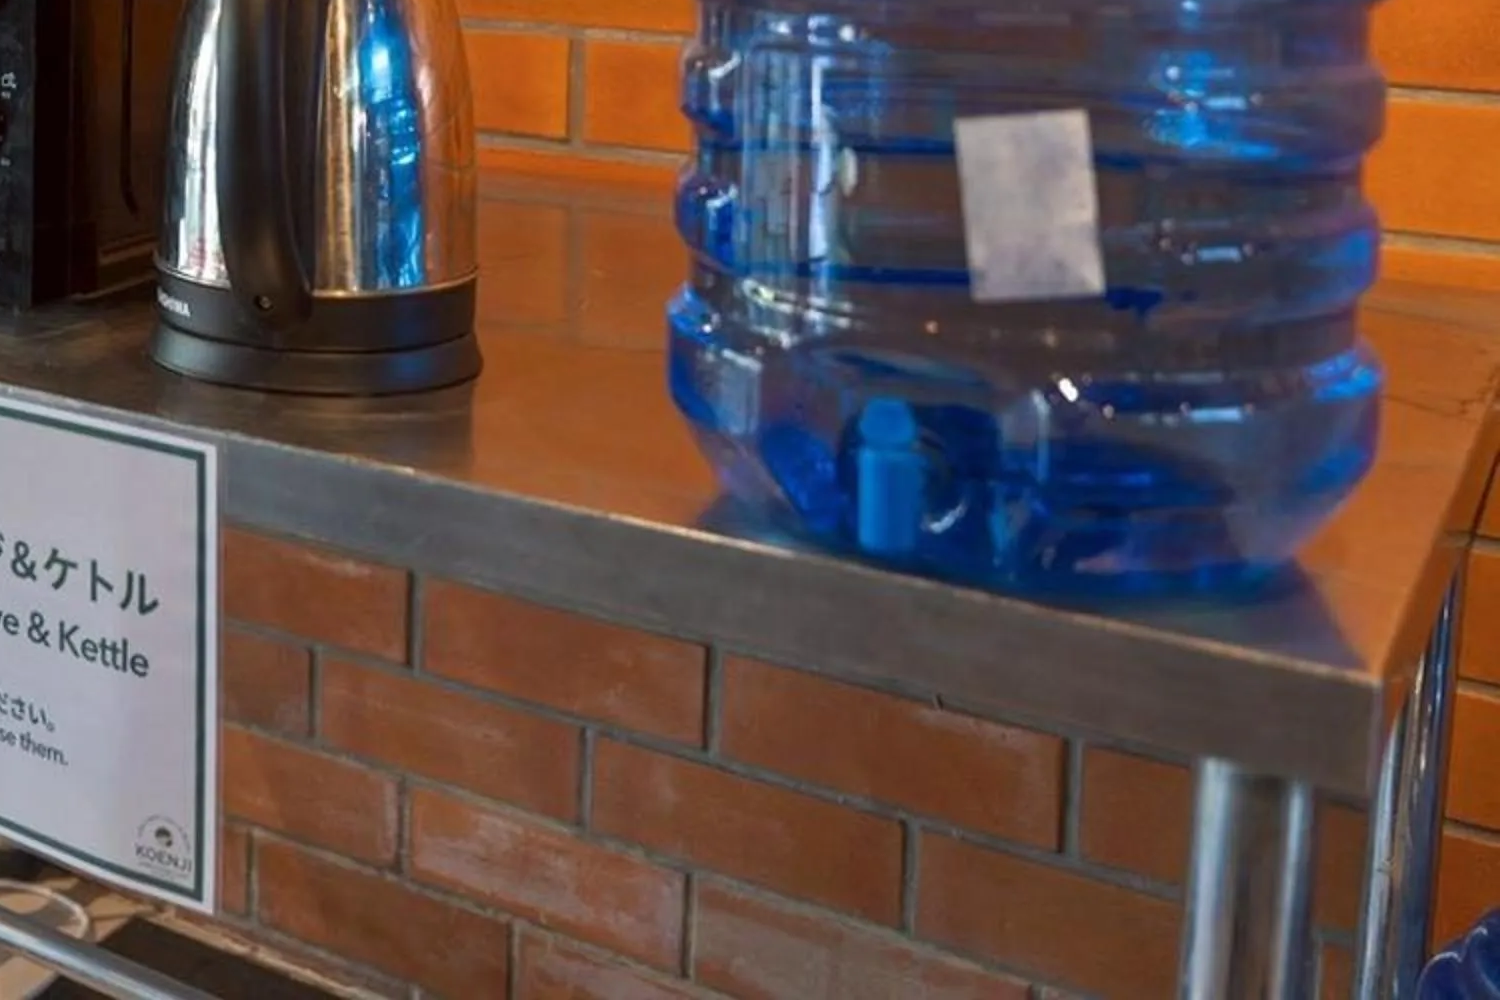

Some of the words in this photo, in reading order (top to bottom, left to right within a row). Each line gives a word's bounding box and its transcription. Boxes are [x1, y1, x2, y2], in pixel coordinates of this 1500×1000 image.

[26, 609, 52, 649] &
[58, 619, 151, 680] Kettle
[18, 730, 70, 768] them.
[134, 842, 193, 873] KOENJI
